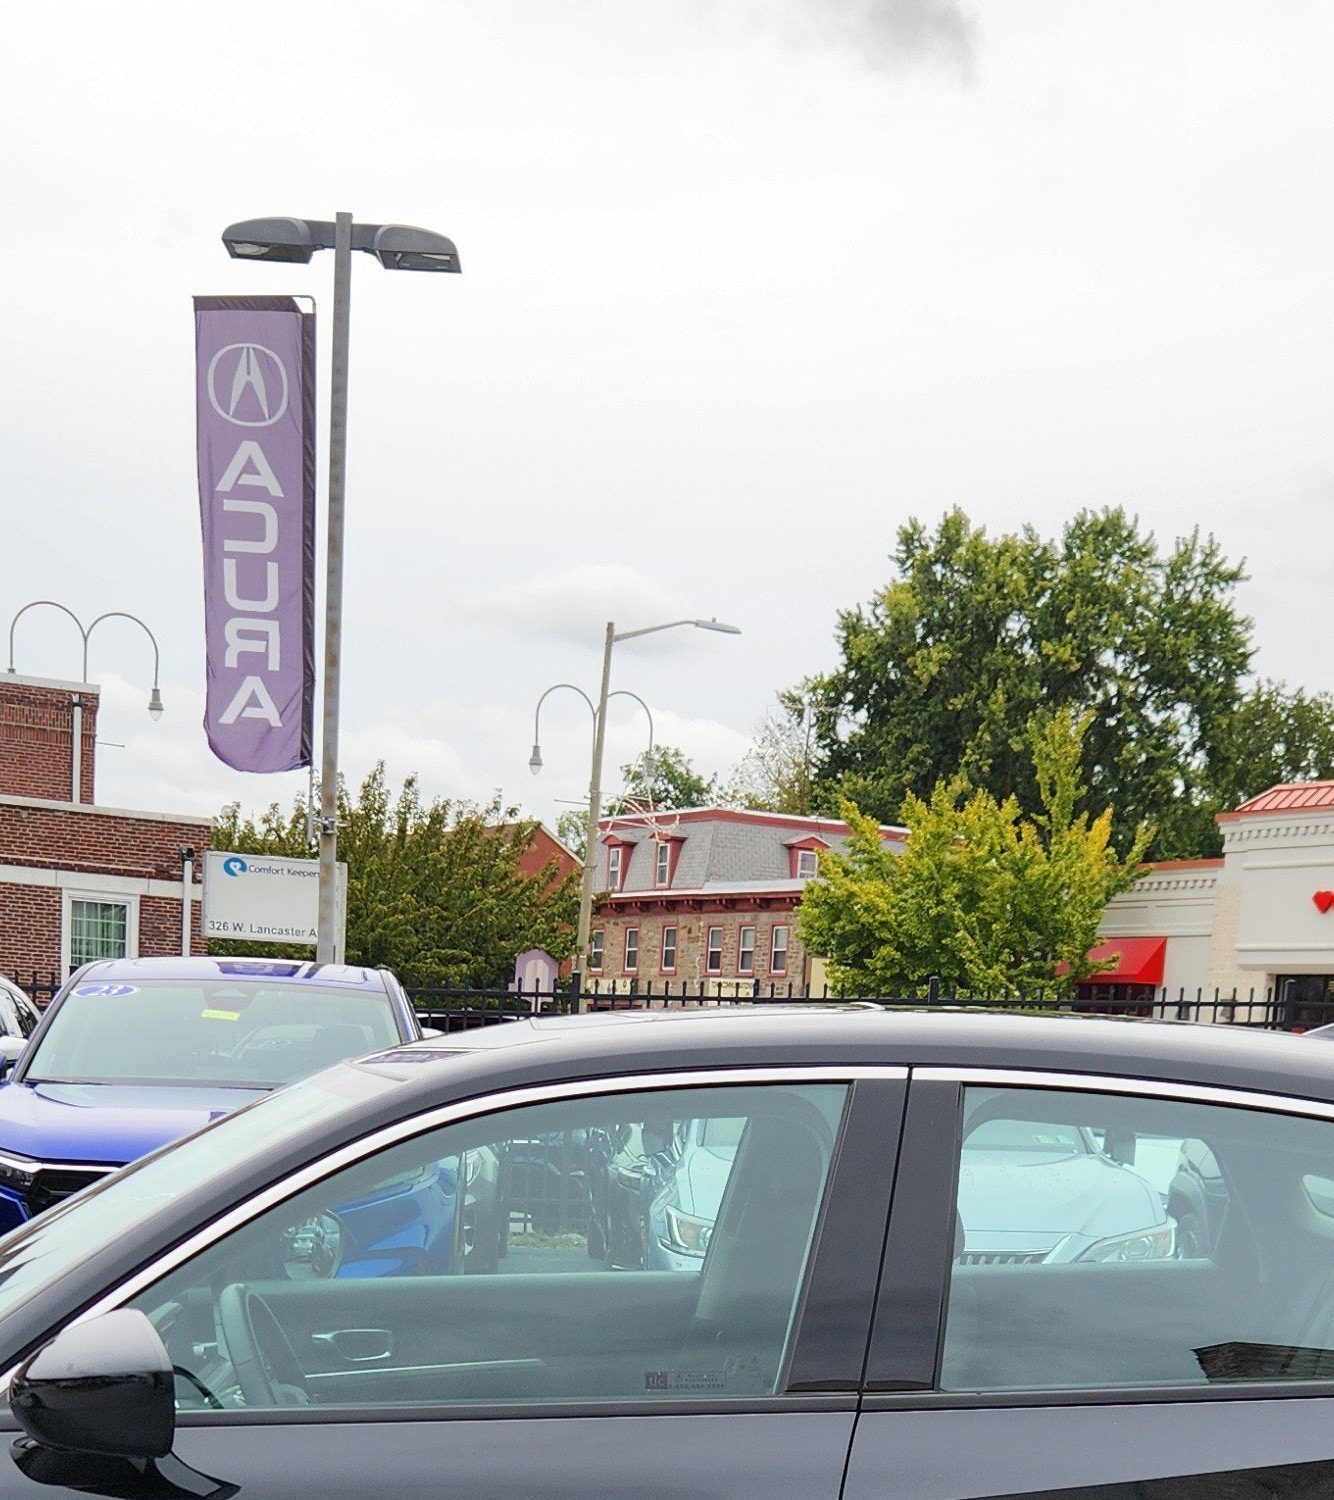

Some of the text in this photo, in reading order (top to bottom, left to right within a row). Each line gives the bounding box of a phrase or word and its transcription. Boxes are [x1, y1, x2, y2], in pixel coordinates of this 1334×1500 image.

[249, 865, 284, 876] Comfort
[209, 921, 229, 931] 326
[233, 923, 246, 933] W.
[250, 924, 305, 937] Lancaster
